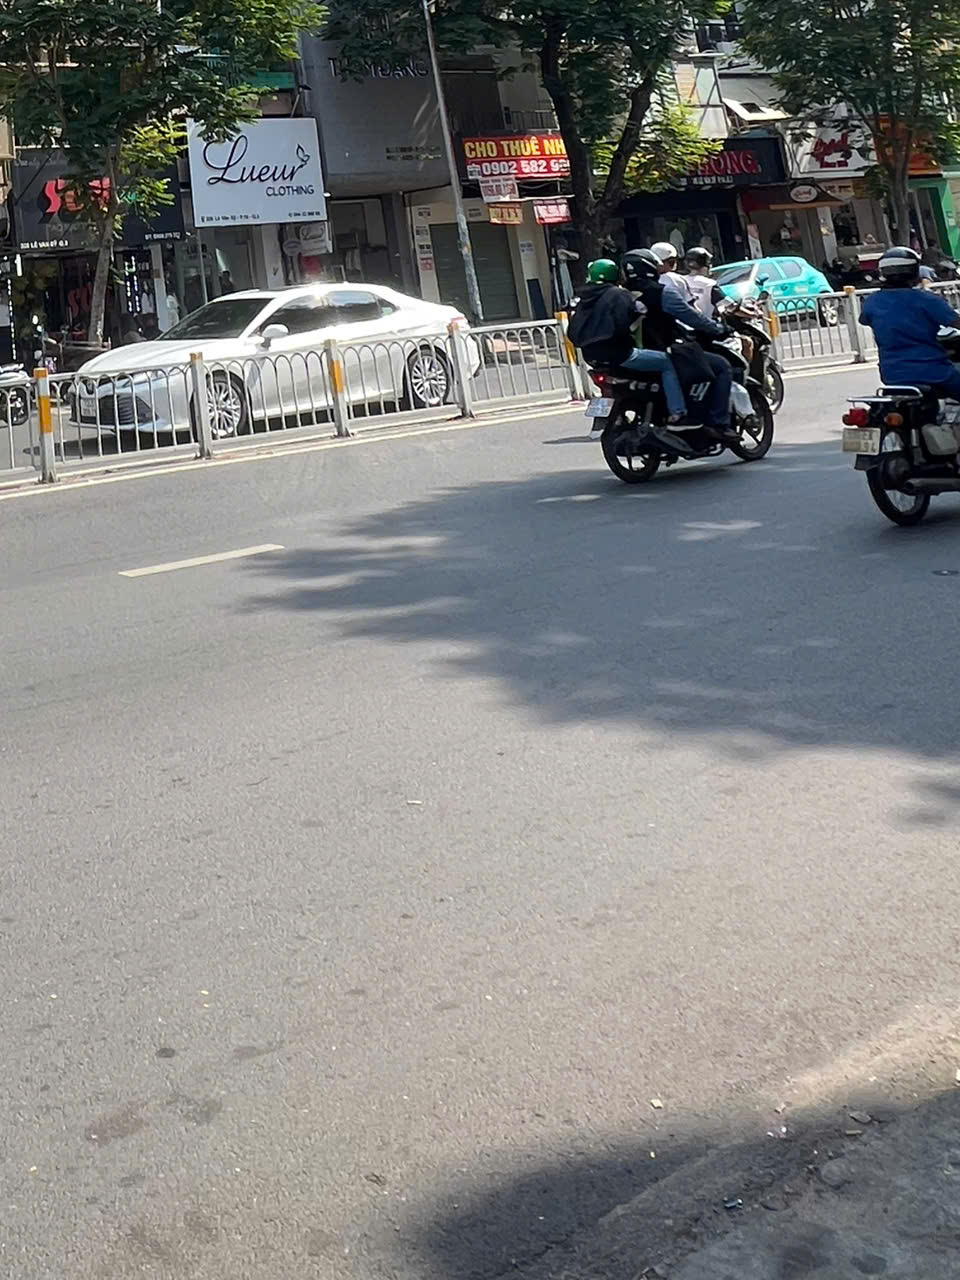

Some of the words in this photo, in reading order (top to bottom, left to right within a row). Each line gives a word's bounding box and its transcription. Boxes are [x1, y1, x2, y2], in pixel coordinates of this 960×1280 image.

[463, 141, 498, 158] CHO
[500, 135, 541, 157] THUÊ
[543, 138, 566, 155] NH
[203, 134, 301, 185] Lueur
[481, 160, 518, 176] 0902
[520, 160, 547, 173] 582
[266, 185, 314, 197] CLOTHING
